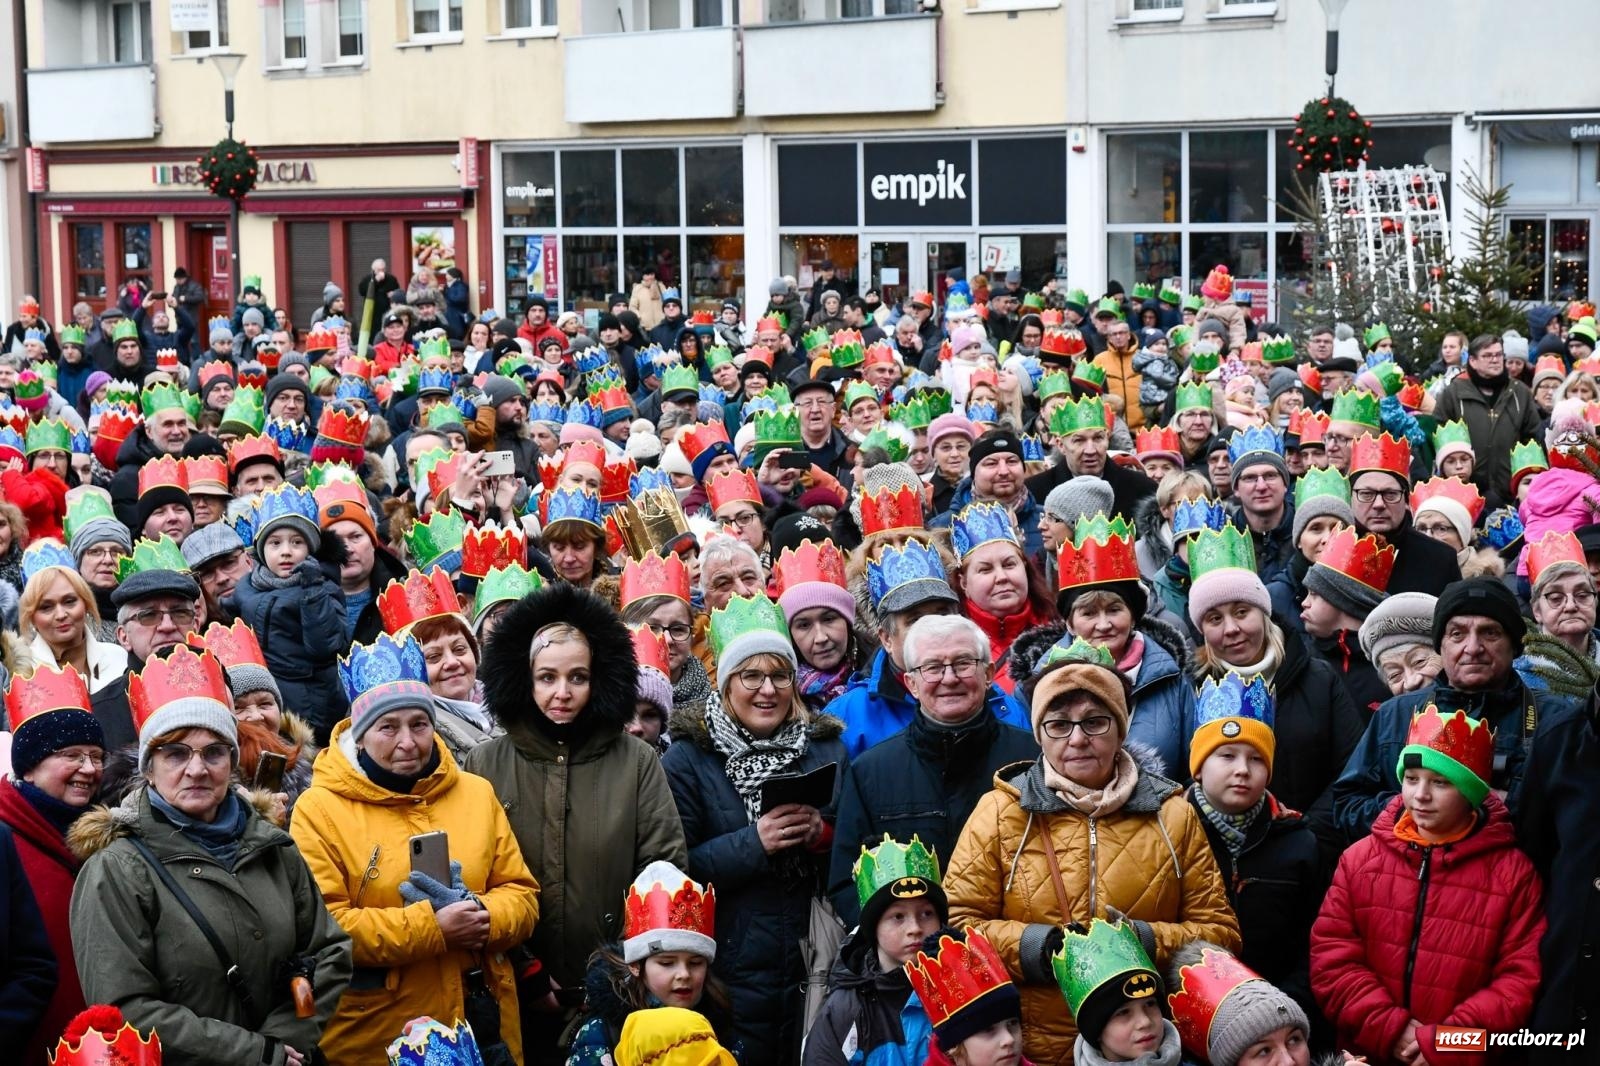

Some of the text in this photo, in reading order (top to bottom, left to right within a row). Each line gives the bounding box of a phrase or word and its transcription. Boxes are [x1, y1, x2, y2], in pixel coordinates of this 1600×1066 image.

[1570, 123, 1600, 139] gelat
[505, 181, 554, 199] empik.com
[871, 159, 967, 206] empik
[1526, 705, 1536, 731] Nikon
